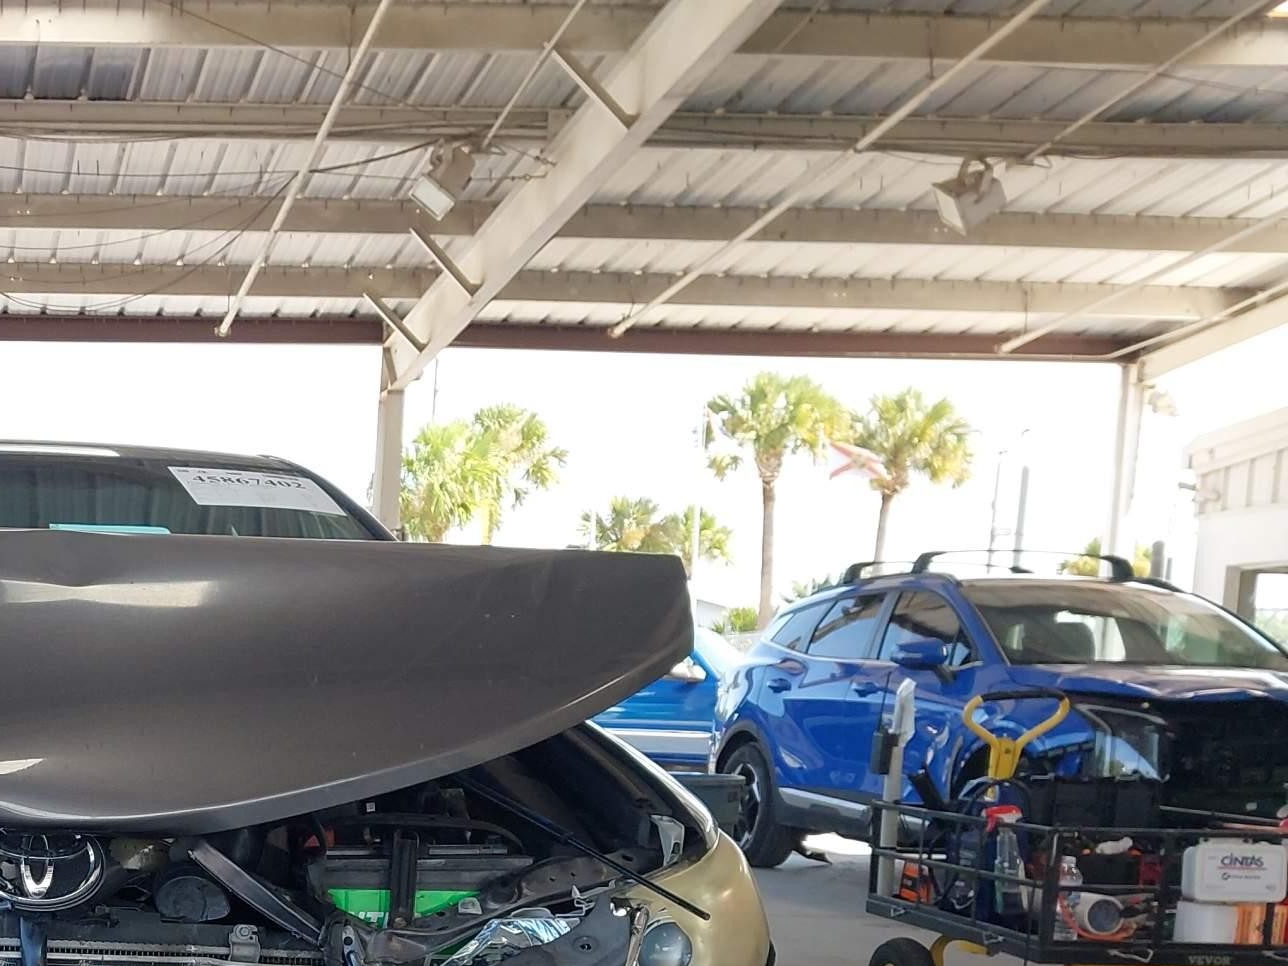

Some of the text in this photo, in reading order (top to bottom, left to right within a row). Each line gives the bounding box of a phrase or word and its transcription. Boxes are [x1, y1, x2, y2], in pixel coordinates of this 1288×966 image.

[192, 474, 306, 489] 45867402
[1220, 852, 1265, 868] CINTAS
[1187, 955, 1232, 966] VEVOR
